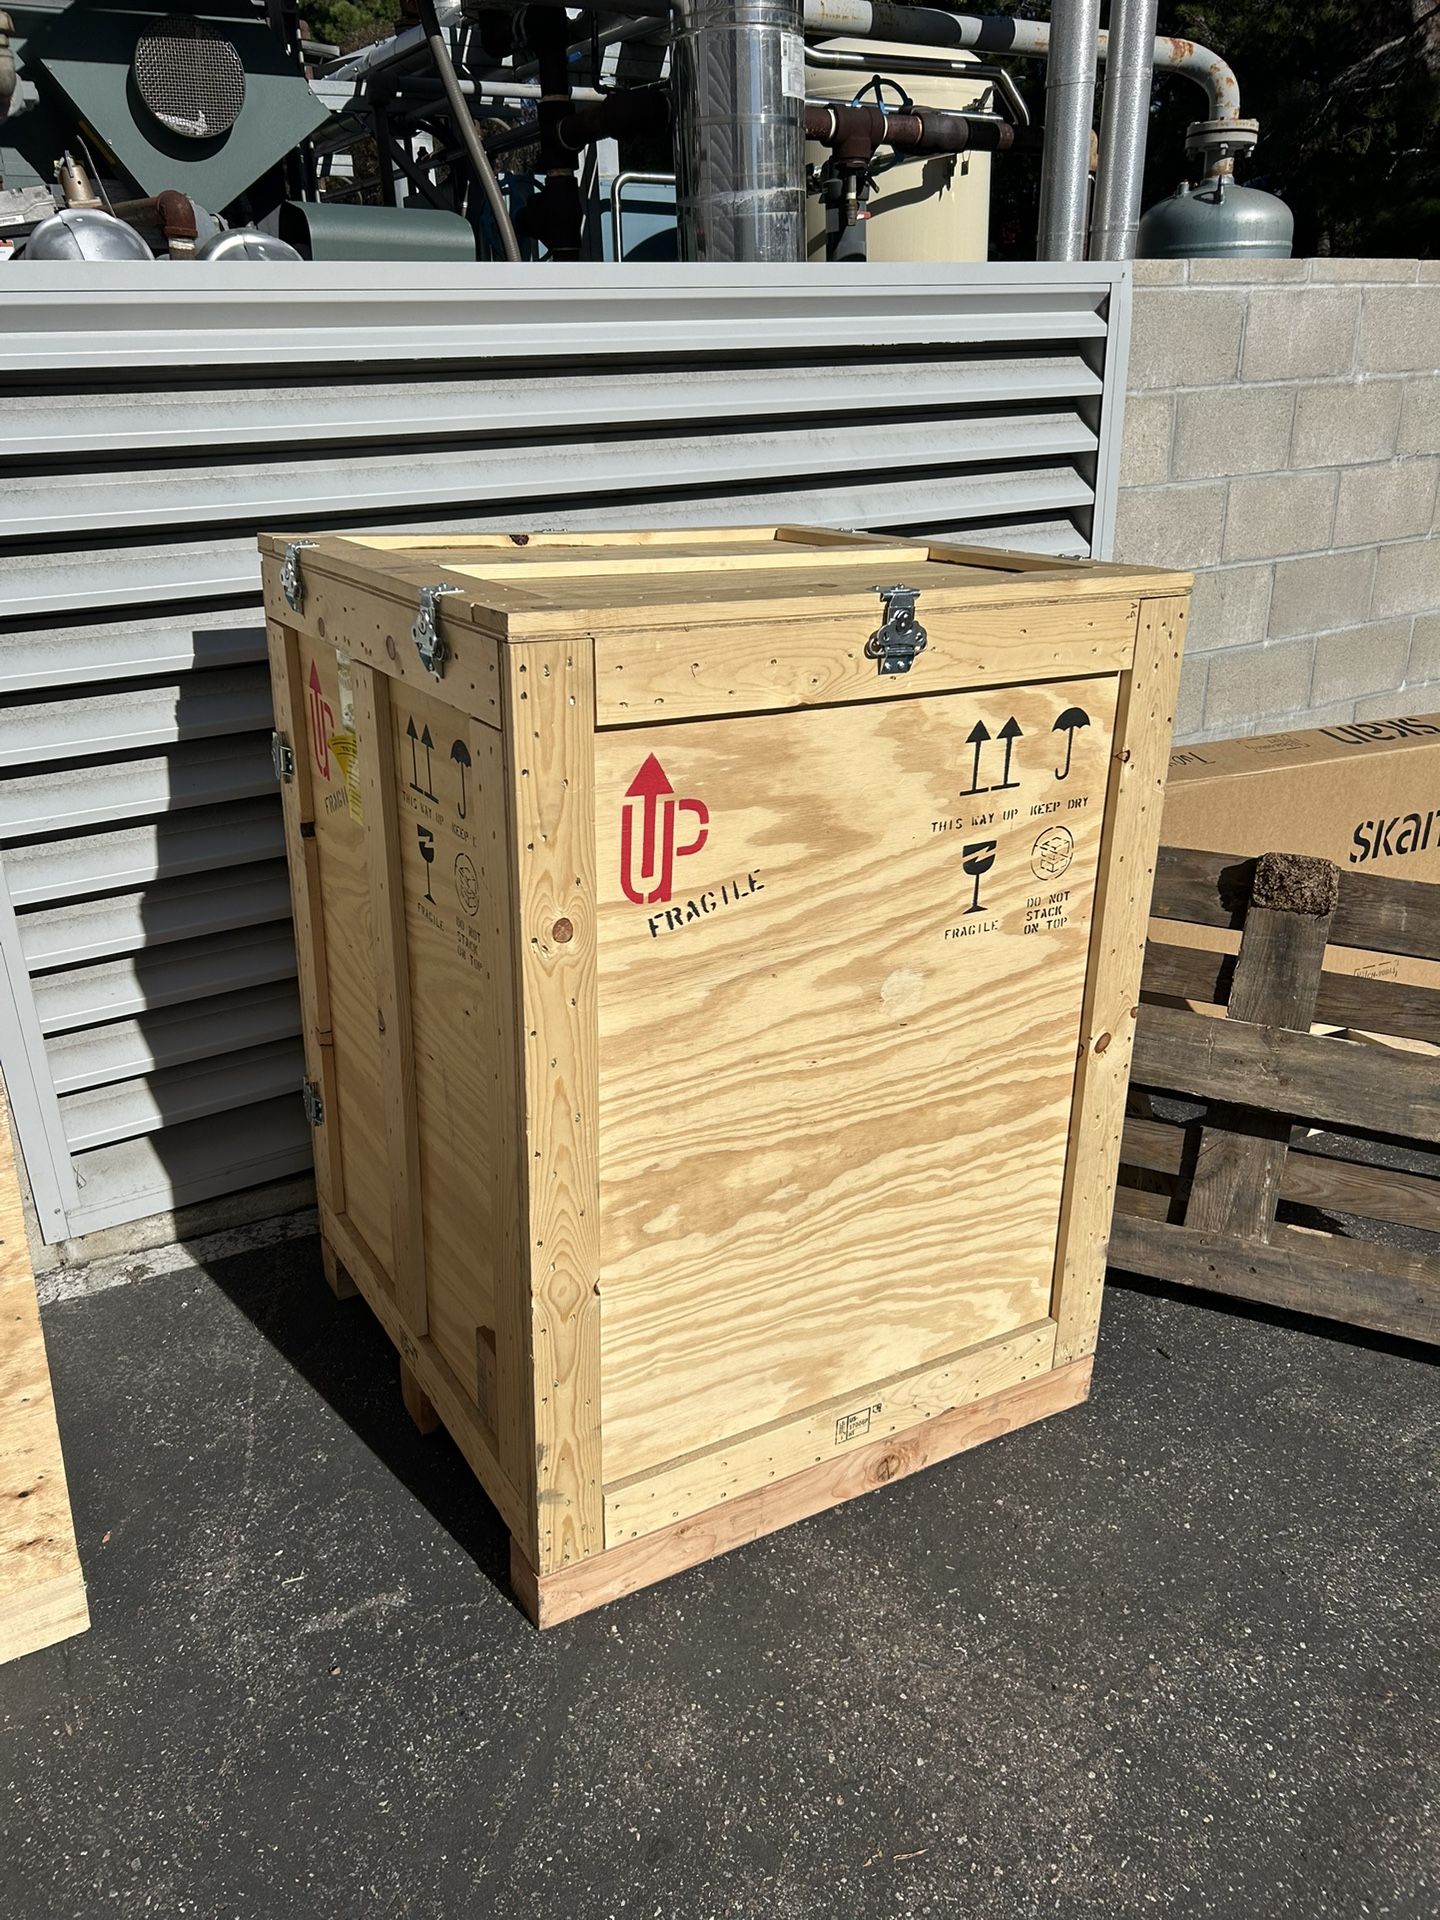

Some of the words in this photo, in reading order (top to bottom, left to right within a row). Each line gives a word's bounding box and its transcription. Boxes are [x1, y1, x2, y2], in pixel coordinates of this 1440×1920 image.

[402, 790, 417, 810] THIS
[1029, 800, 1061, 817] KEEP
[1067, 796, 1089, 809] DRY
[931, 818, 963, 833] THIS
[971, 812, 995, 826] WAY
[1002, 808, 1019, 821] UP
[452, 822, 469, 842] KEEP
[620, 798, 710, 905] UP
[647, 868, 765, 938] FRAGILE
[1026, 896, 1042, 908] DO
[1048, 890, 1071, 905] NOT
[417, 902, 444, 932] FRAGILE
[1026, 905, 1062, 922] STACK
[944, 919, 999, 940] FRAGILE
[1023, 923, 1039, 935] ON
[1046, 917, 1068, 930] TOP
[457, 930, 478, 956] STACK
